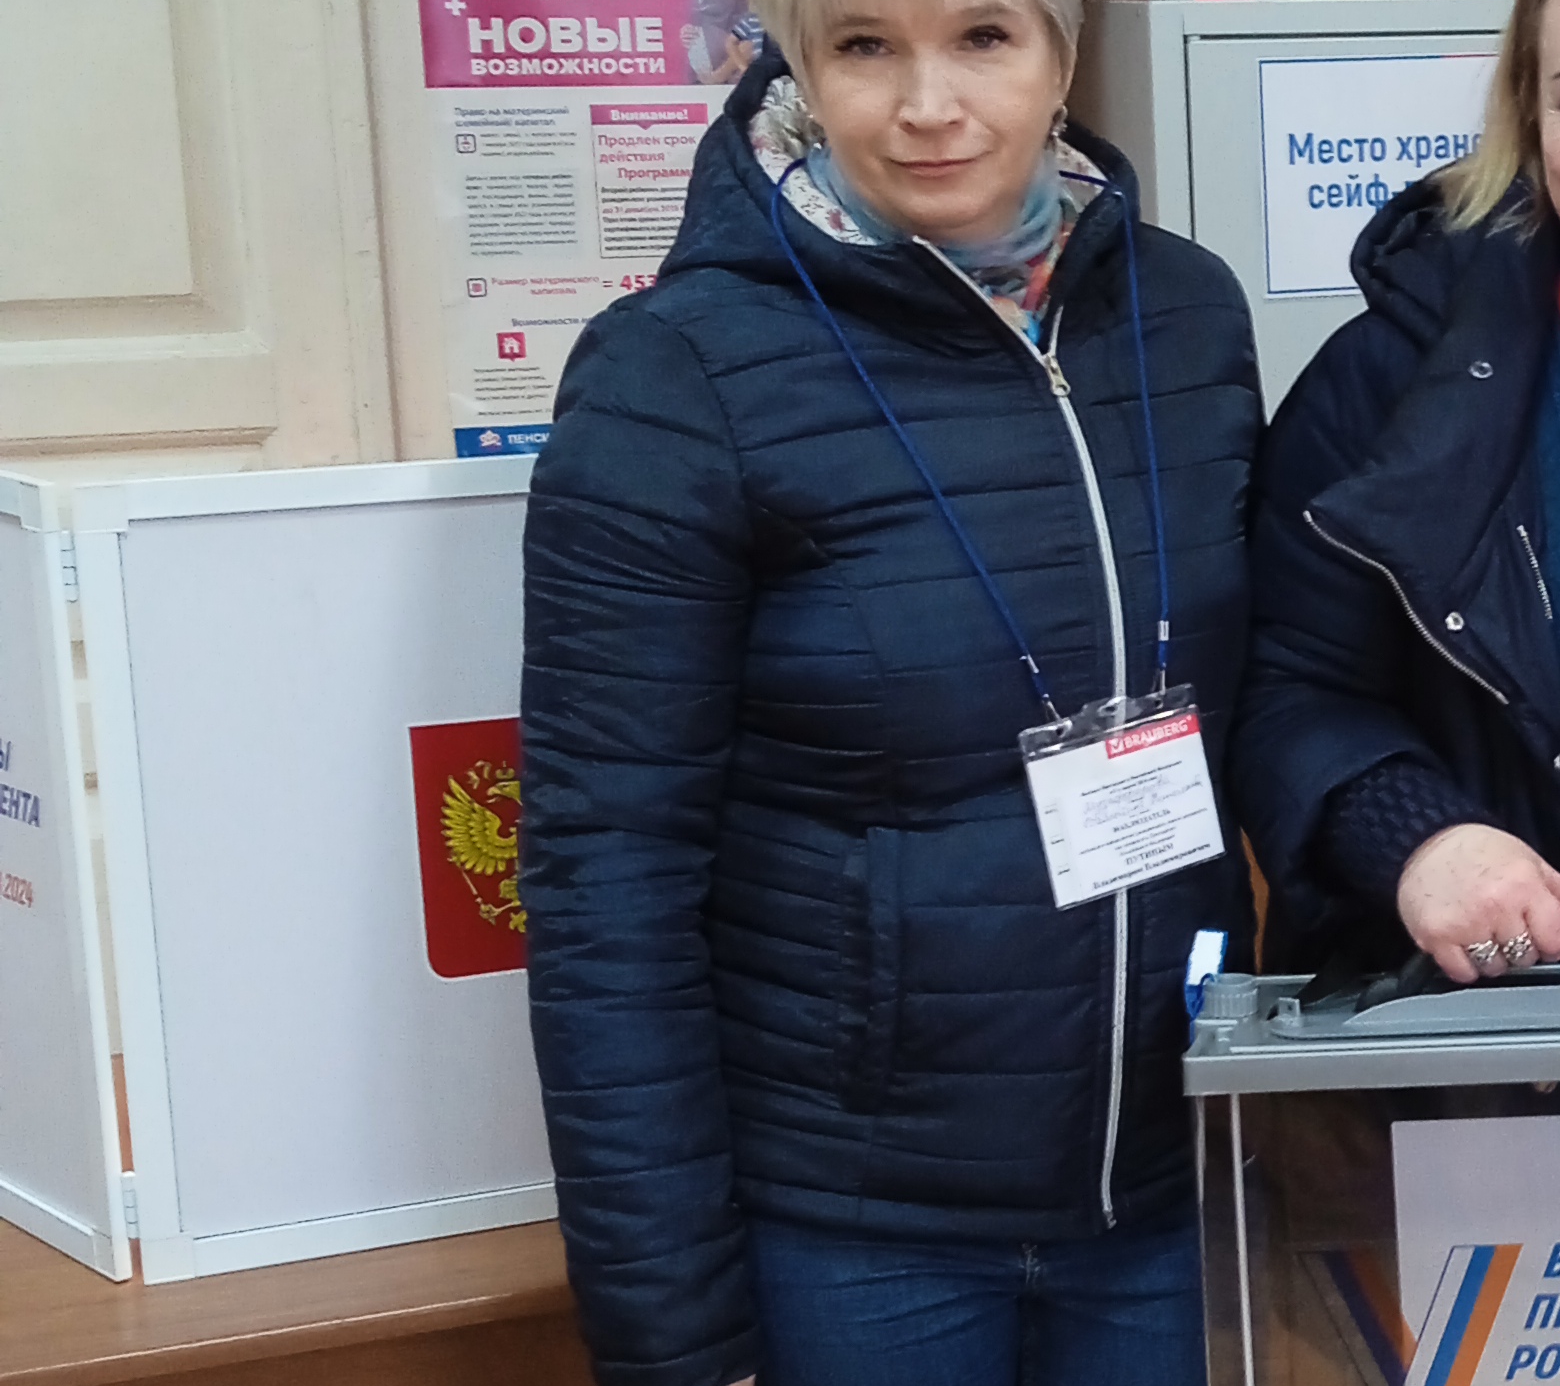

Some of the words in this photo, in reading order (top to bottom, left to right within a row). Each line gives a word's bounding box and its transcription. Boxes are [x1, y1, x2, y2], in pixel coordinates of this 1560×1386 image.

[468, 17, 664, 53] НОВЫЕ
[471, 58, 666, 75] ВОЗМОЖНОСТИ
[610, 109, 688, 121] Внимание!
[598, 135, 661, 148] Продлен
[664, 135, 697, 146] срок
[1288, 132, 1387, 165] Место
[599, 151, 665, 163] действия
[618, 167, 693, 181] Программ
[1124, 720, 1188, 748] BRAUBERG
